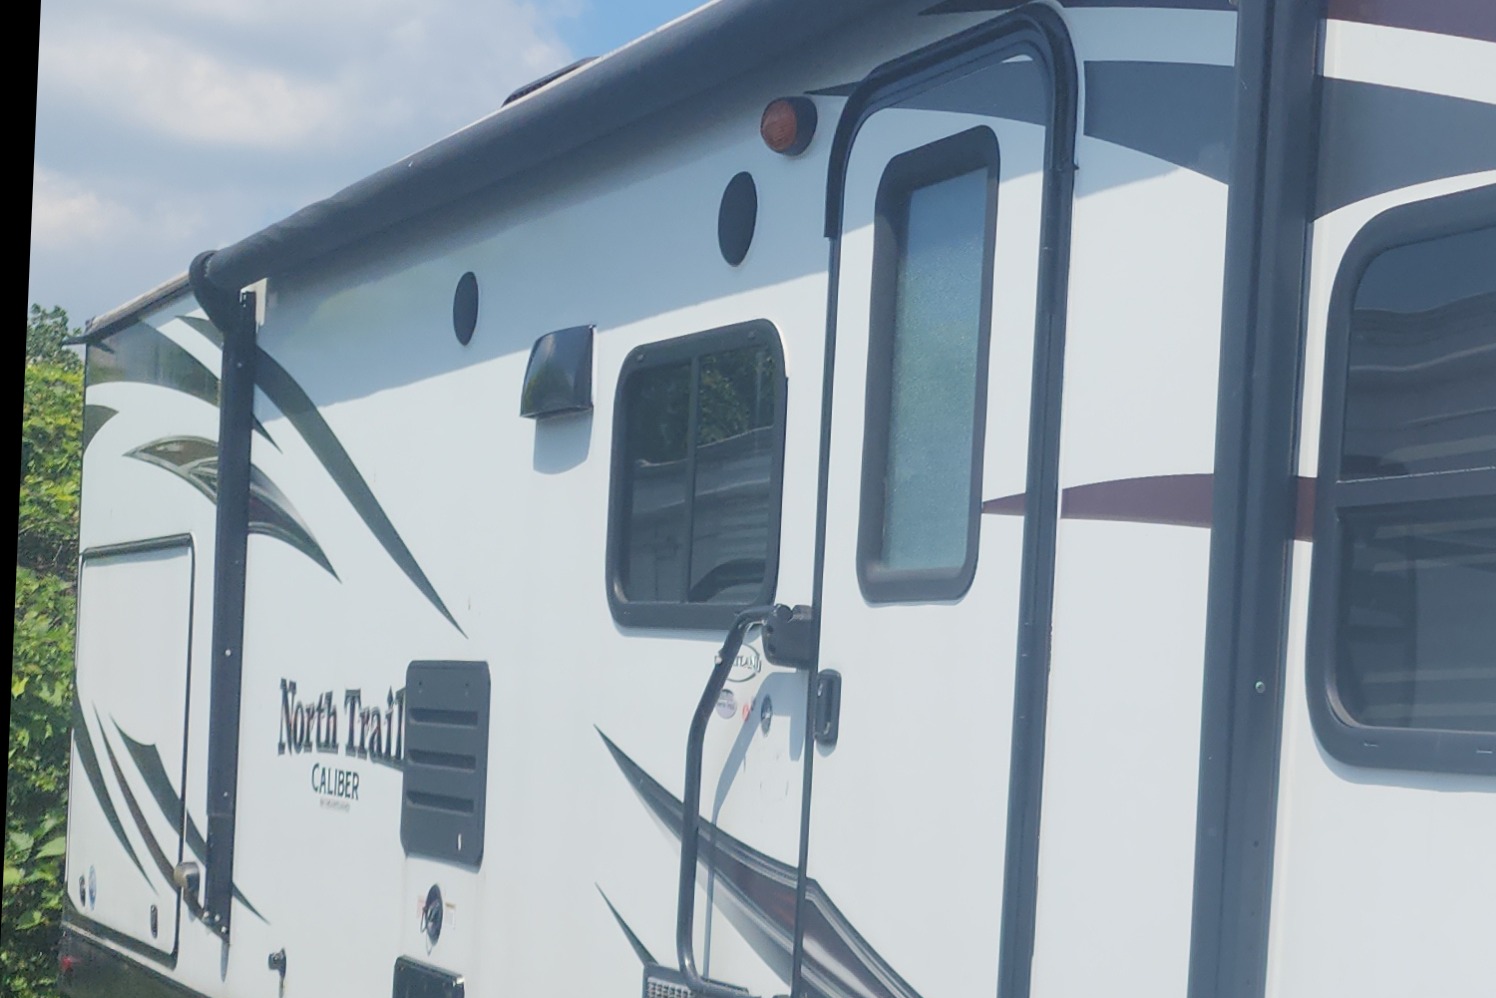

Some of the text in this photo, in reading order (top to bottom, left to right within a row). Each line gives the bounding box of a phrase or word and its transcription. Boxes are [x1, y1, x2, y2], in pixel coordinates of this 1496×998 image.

[277, 677, 405, 772] North Trail
[311, 762, 360, 801] CALIBER
